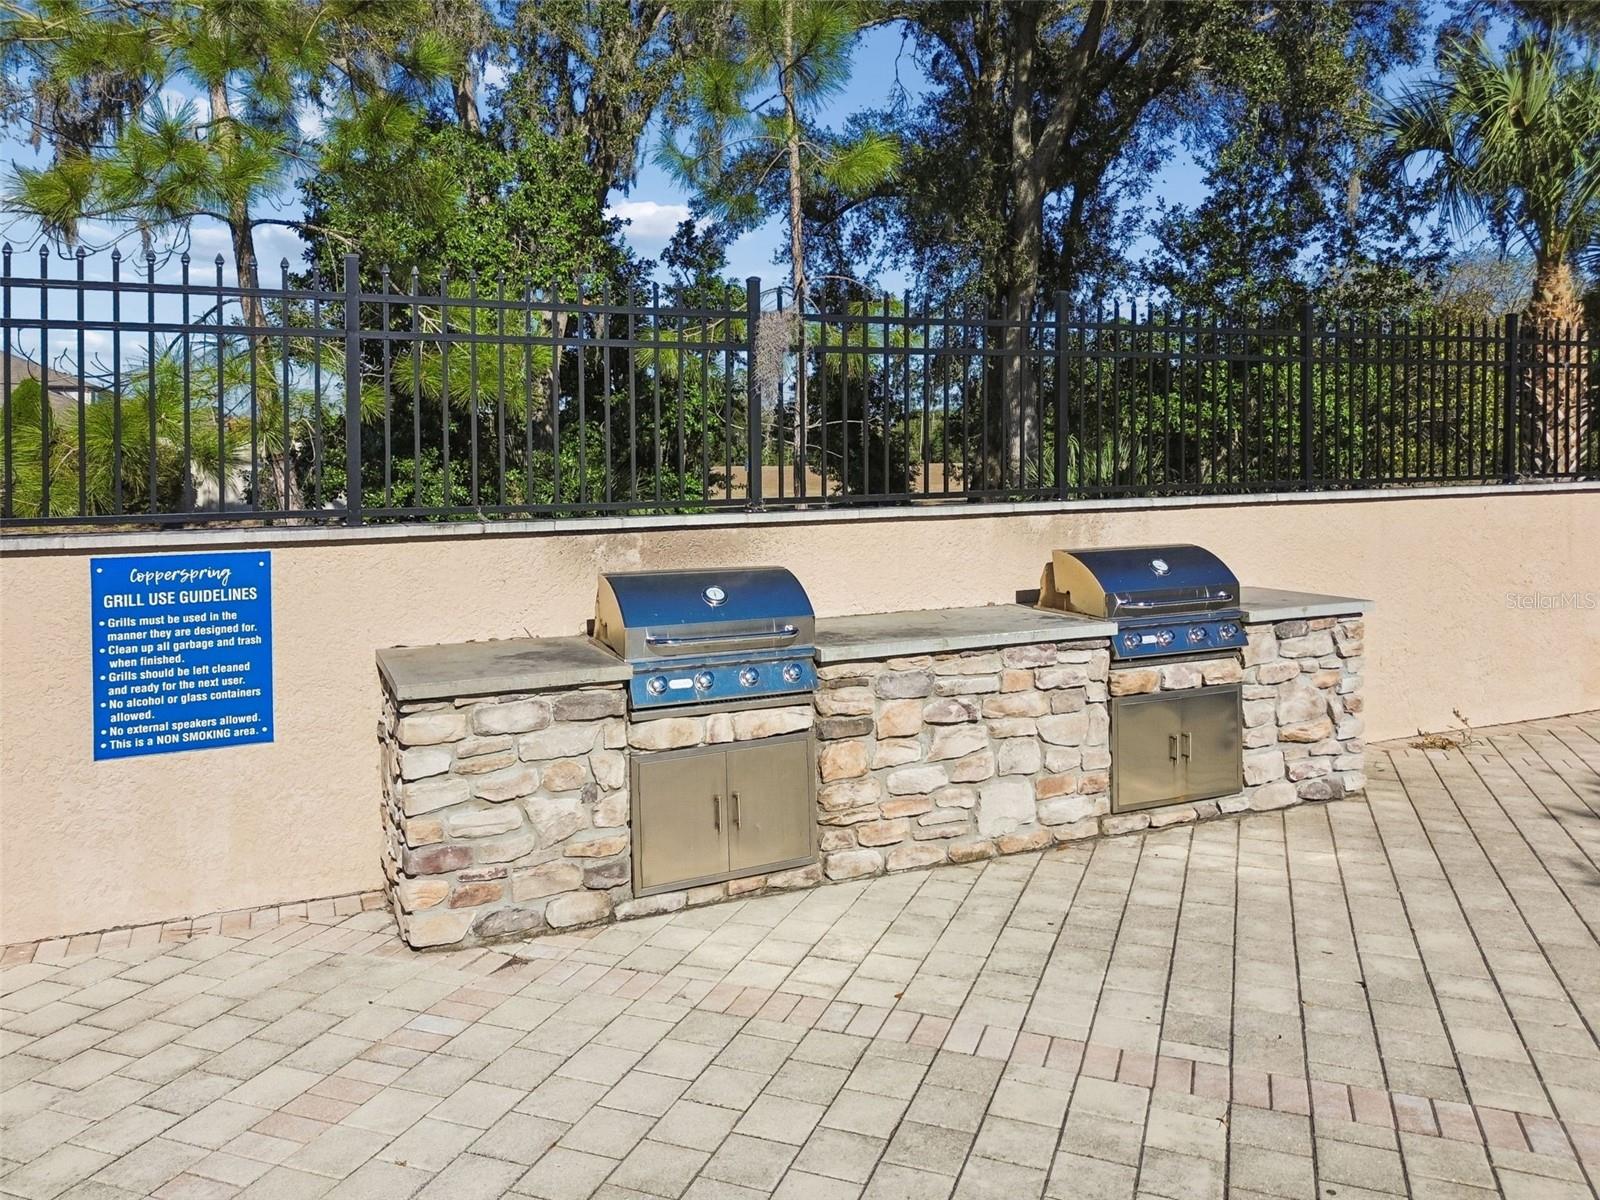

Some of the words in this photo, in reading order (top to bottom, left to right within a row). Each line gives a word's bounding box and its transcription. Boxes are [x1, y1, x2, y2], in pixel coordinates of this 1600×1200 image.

[130, 566, 231, 586] Copperspring
[104, 594, 144, 608] GRILL
[149, 591, 175, 606] USE
[180, 587, 257, 603] GUIDELINES
[108, 618, 136, 628] Grills
[140, 615, 164, 626] must
[168, 615, 180, 624] be
[183, 613, 206, 622] used
[210, 612, 218, 621] in
[222, 611, 237, 620] the
[108, 631, 147, 641] manner
[150, 629, 171, 640] they
[175, 629, 191, 637] are
[194, 624, 239, 635] designed
[241, 624, 257, 632] for.
[108, 645, 137, 655] Clean
[141, 644, 153, 653] up
[157, 642, 169, 650] all
[173, 639, 213, 650] garbage
[217, 638, 234, 647] and
[238, 636, 261, 644] trash
[109, 658, 137, 668] when
[141, 654, 184, 666] finished.
[109, 672, 137, 682] Grills
[140, 668, 173, 680] should
[178, 668, 189, 676] be
[193, 666, 209, 675] left
[212, 662, 250, 673] cleaned
[108, 686, 127, 695] and
[131, 683, 158, 693] ready
[162, 681, 175, 690] for
[180, 680, 195, 689] the
[199, 678, 218, 688] next
[222, 676, 245, 685] user.
[109, 700, 123, 709] No
[126, 695, 164, 707] alcohol
[167, 695, 177, 703] or
[181, 692, 207, 704] glass
[210, 688, 261, 700] containers
[110, 711, 155, 722] allowed.
[110, 727, 123, 736] No
[127, 722, 168, 734] external
[172, 717, 216, 730] speakers
[220, 713, 261, 725] allowed.
[110, 740, 131, 749] This
[135, 738, 143, 747] is
[157, 734, 179, 744] NON
[182, 729, 231, 742] SMOKING
[234, 728, 258, 736] area.
